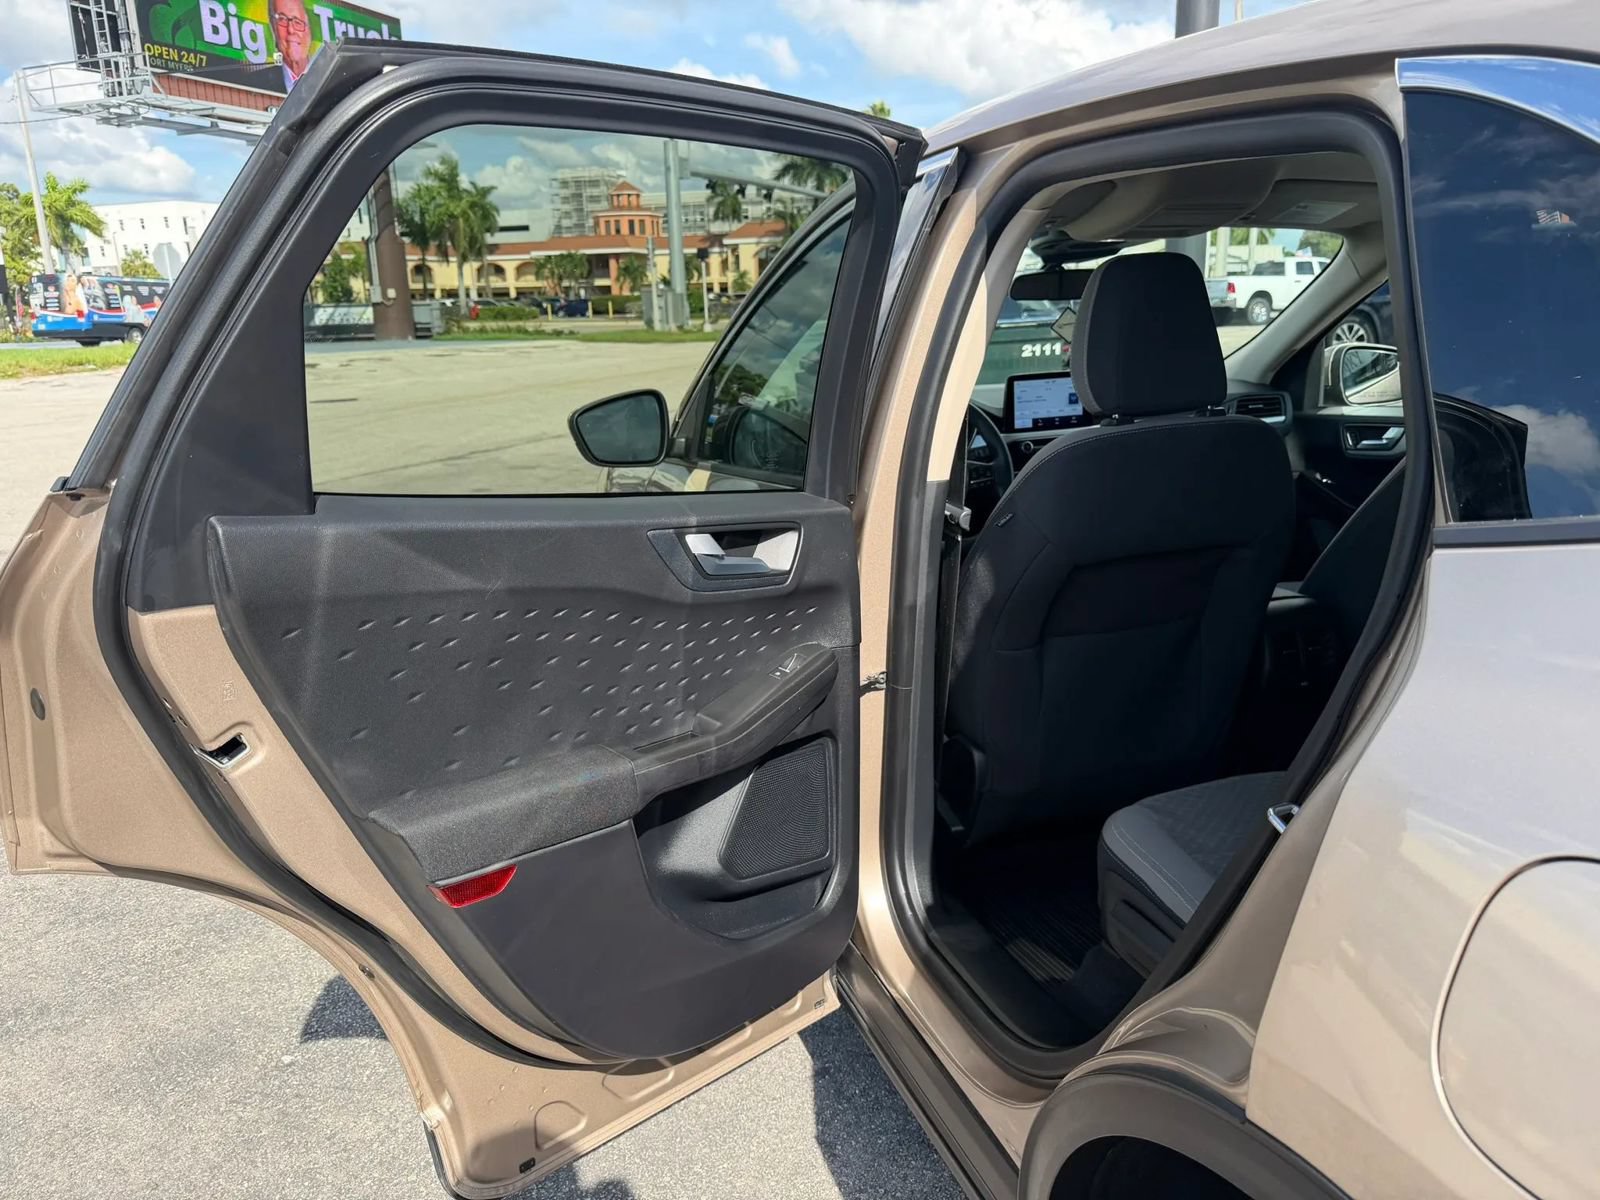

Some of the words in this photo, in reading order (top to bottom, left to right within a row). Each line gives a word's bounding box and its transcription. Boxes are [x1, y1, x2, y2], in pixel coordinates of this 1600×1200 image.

[199, 0, 267, 64] Big
[144, 43, 179, 61] OPEN
[181, 51, 207, 67] 24/7
[150, 57, 166, 67] ORT
[1021, 342, 1062, 357] 2111
